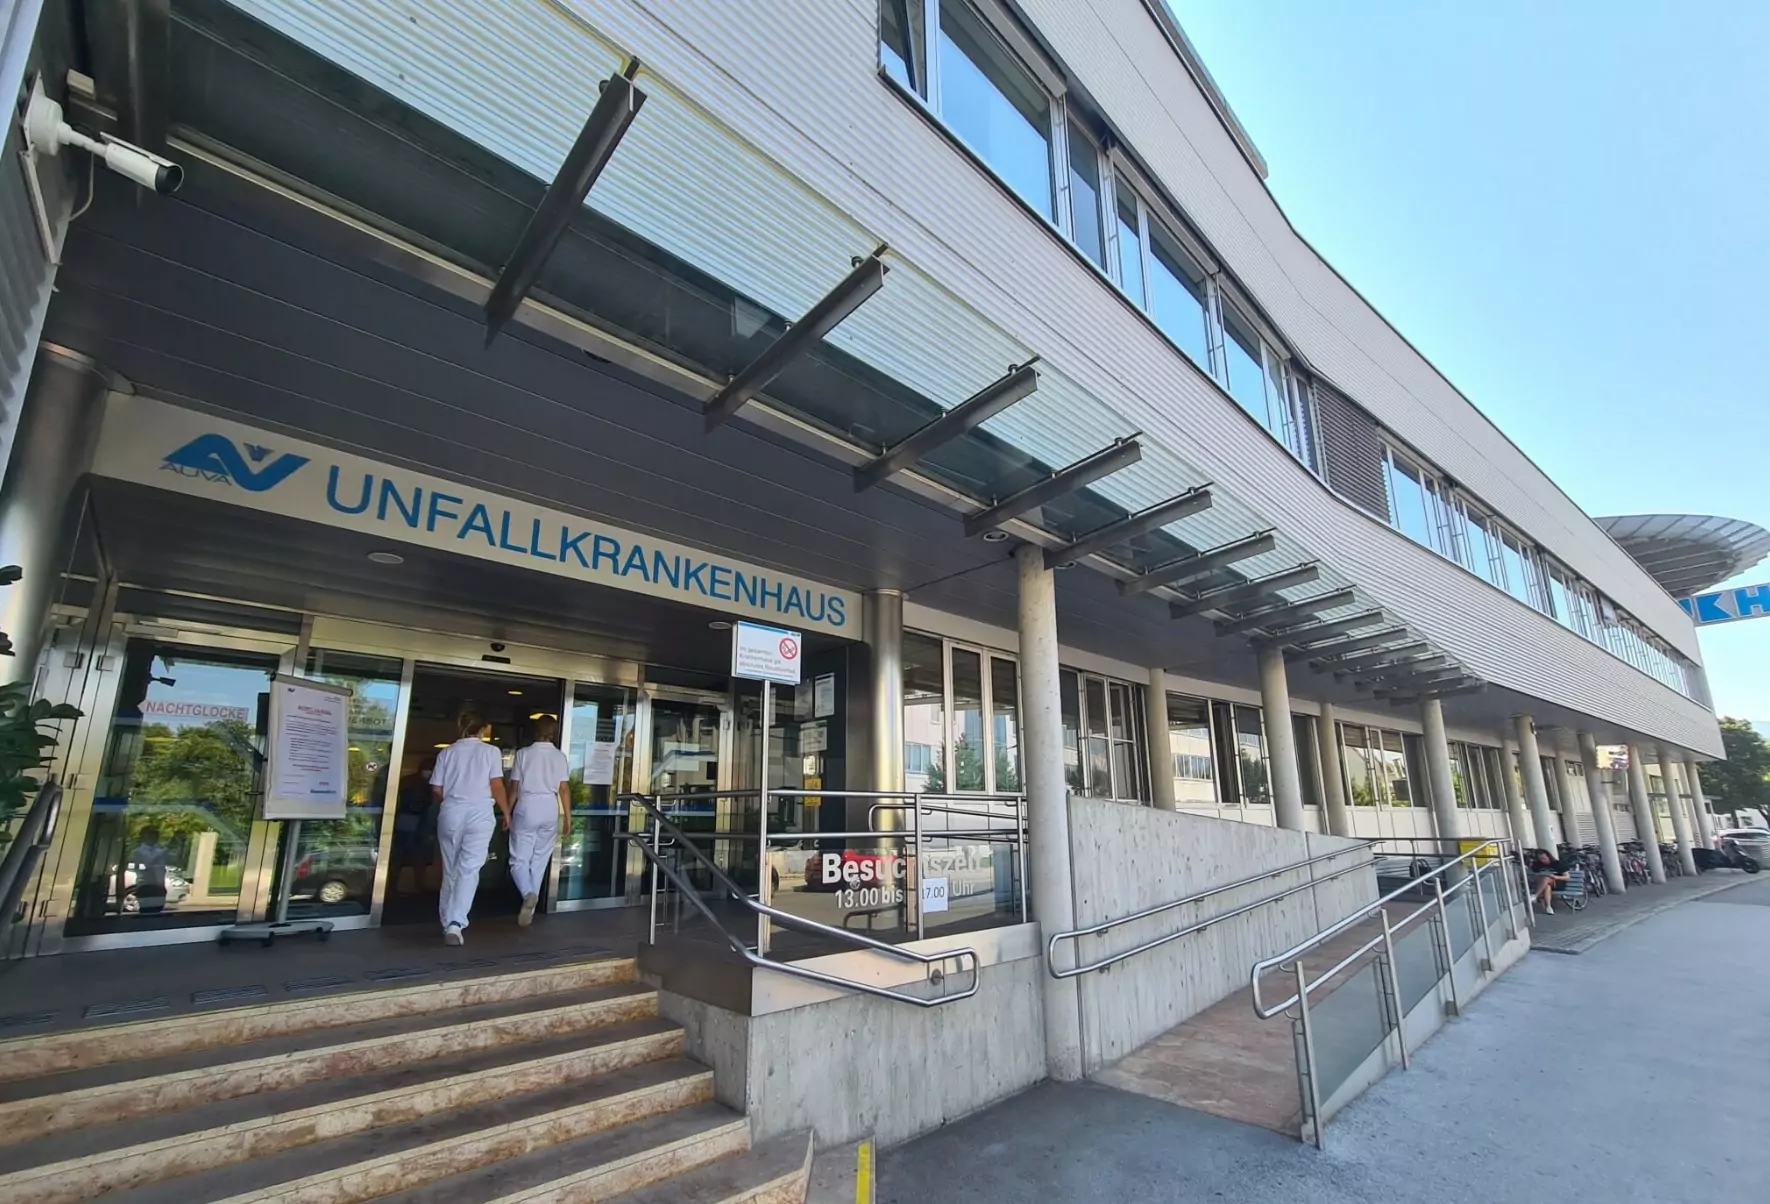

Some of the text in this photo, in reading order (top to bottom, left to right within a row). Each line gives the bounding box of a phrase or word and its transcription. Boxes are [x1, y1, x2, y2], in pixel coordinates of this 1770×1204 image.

[159, 462, 232, 486] AUVA
[326, 464, 846, 627] UNFALLKRANKENHAUS
[1678, 585, 1770, 624] KH
[146, 702, 244, 719] NACHTGLOCKE
[835, 886, 879, 909] 13.00
[882, 884, 904, 904] bis
[952, 880, 975, 896] Uhr
